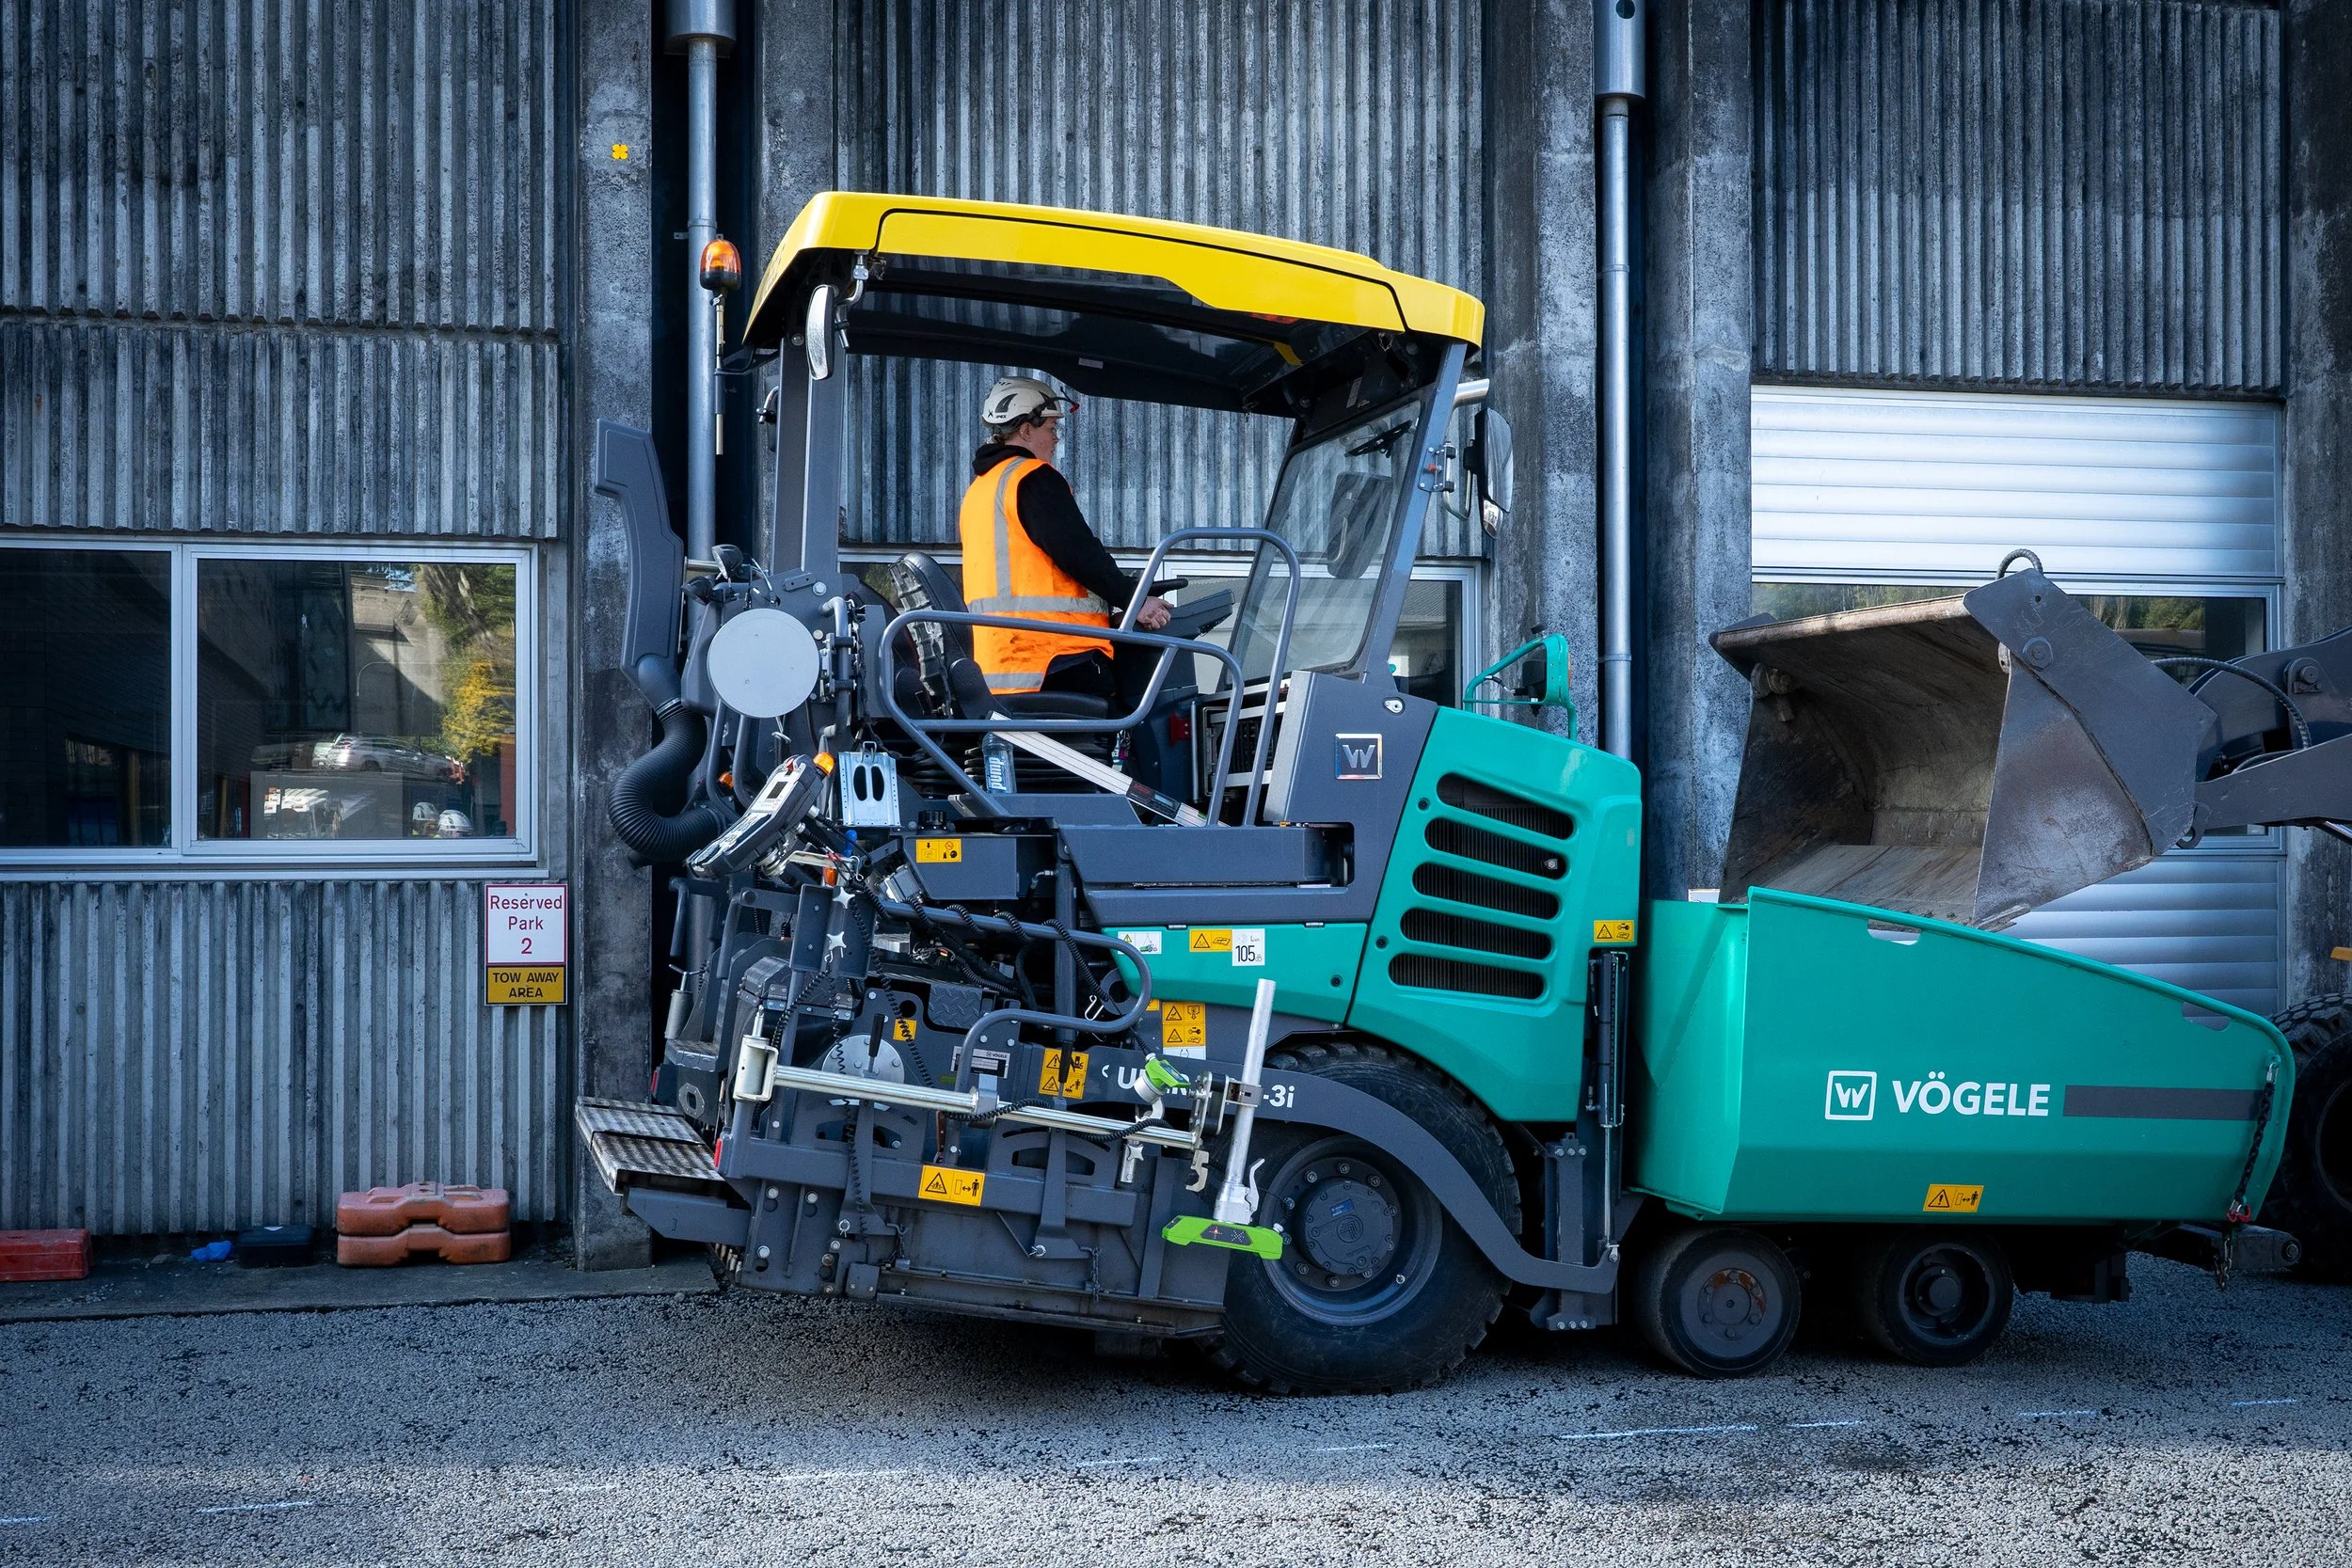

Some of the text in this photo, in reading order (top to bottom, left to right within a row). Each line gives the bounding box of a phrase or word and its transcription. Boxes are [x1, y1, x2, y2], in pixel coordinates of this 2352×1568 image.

[988, 756, 1007, 790] pump
[490, 895, 563, 910] Reserved
[508, 915, 544, 930] Park
[520, 937, 532, 955] 2
[1235, 944, 1256, 962] 105
[492, 972, 560, 983] TOW AWAY
[508, 987, 543, 998] AREA
[1892, 1070, 2051, 1117] VÖGELE
